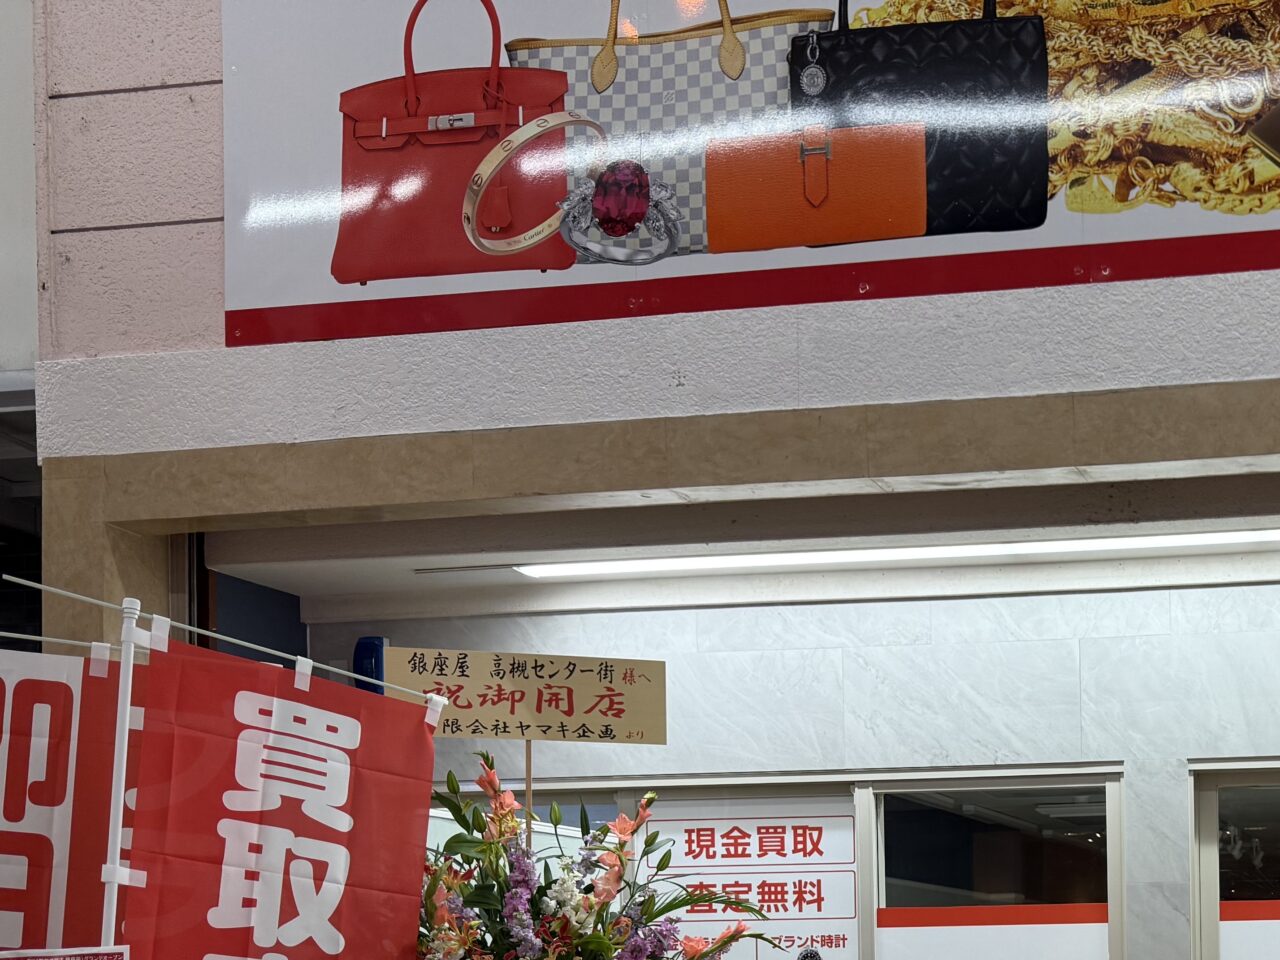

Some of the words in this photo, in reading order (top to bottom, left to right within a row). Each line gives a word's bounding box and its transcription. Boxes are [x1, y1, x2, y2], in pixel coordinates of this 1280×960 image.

[523, 227, 545, 241] Cartier
[408, 652, 471, 679] 銀座屋
[489, 654, 615, 685] 高槻センター街
[422, 680, 626, 719] 祝御開店
[683, 824, 824, 860] 現金買取
[685, 878, 825, 915] 査定無料
[771, 933, 848, 949] ブランド時計
